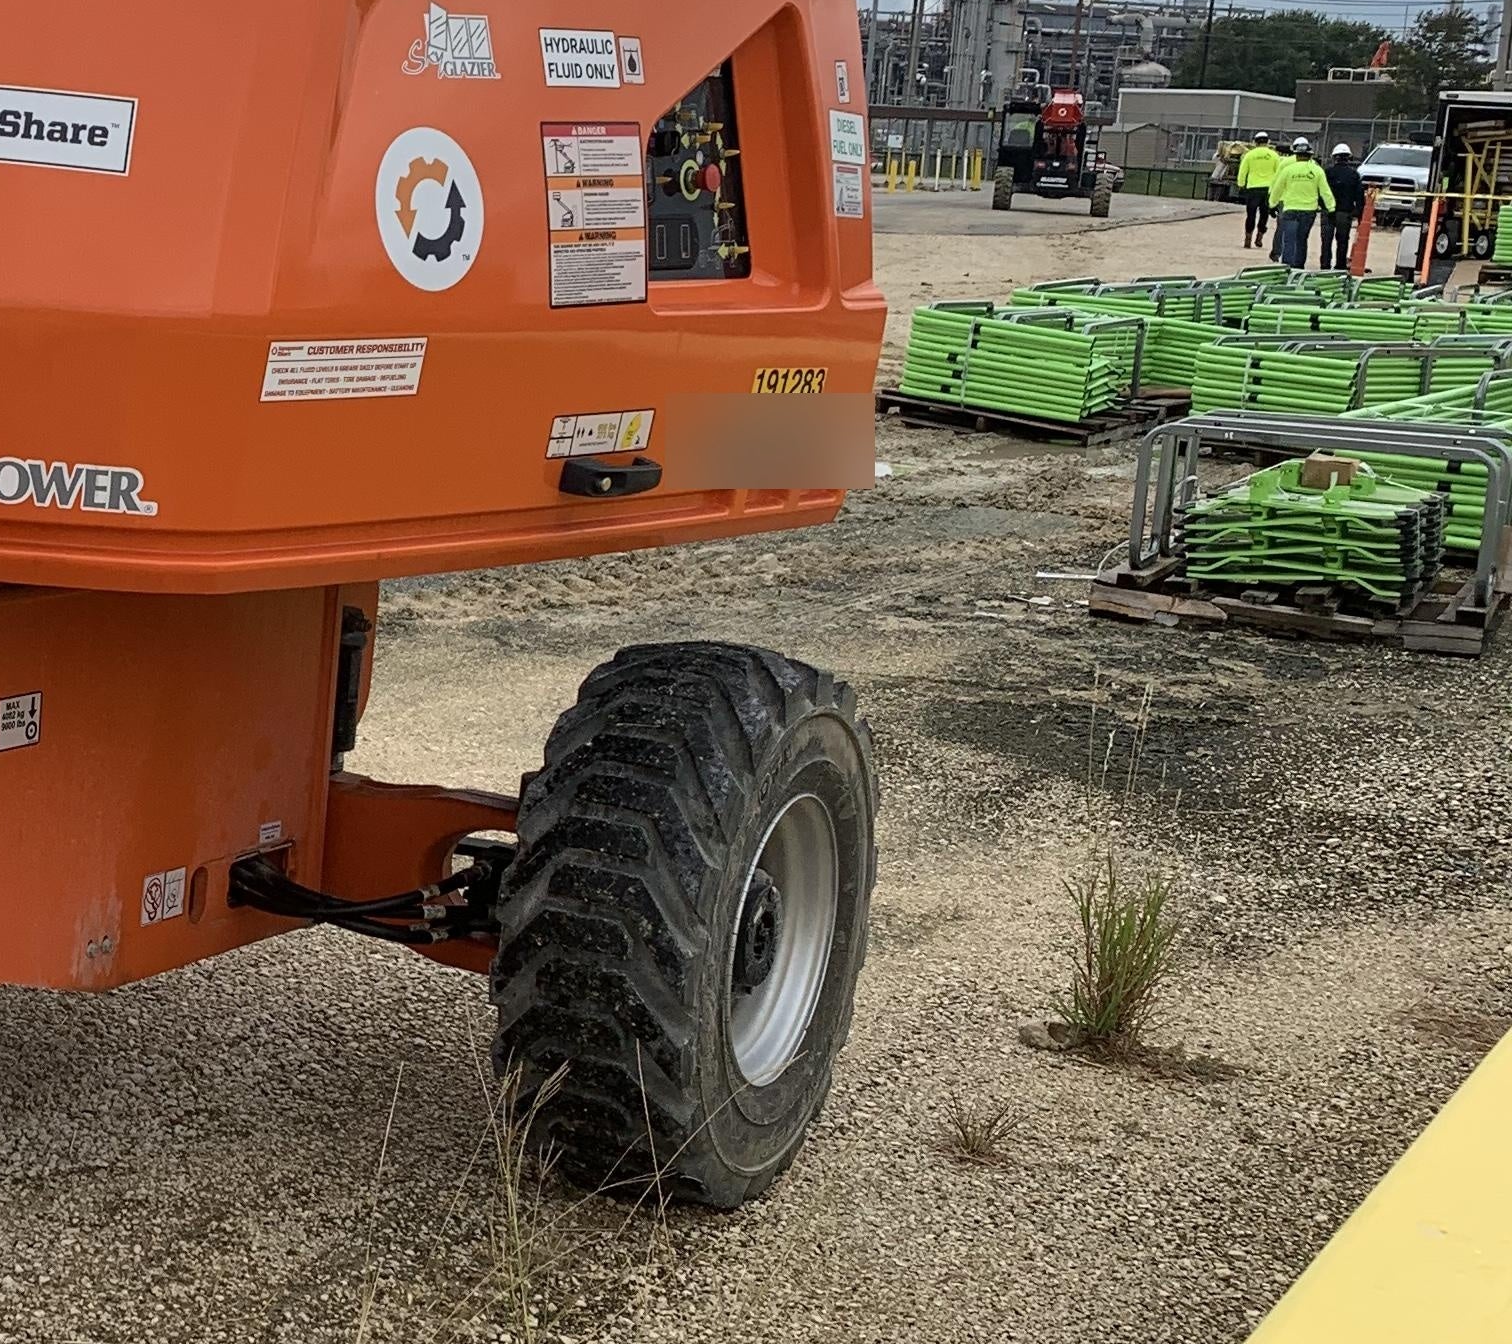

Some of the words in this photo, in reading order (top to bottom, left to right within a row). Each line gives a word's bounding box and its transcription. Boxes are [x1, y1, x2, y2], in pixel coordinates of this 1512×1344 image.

[543, 37, 613, 55] HYDRAULIC
[443, 61, 496, 77] GLAZIER
[547, 63, 583, 78] FLUID
[585, 63, 615, 80] ONLY
[577, 126, 607, 136] DANGER
[836, 118, 858, 135] DIESEL
[832, 139, 848, 155] FUEL
[848, 141, 863, 157] ONLY
[307, 344, 355, 356] CUSTOMER
[355, 342, 426, 355] RESPONSIBILITY
[756, 368, 826, 394] 191283
[6, 700, 20, 710] MAX
